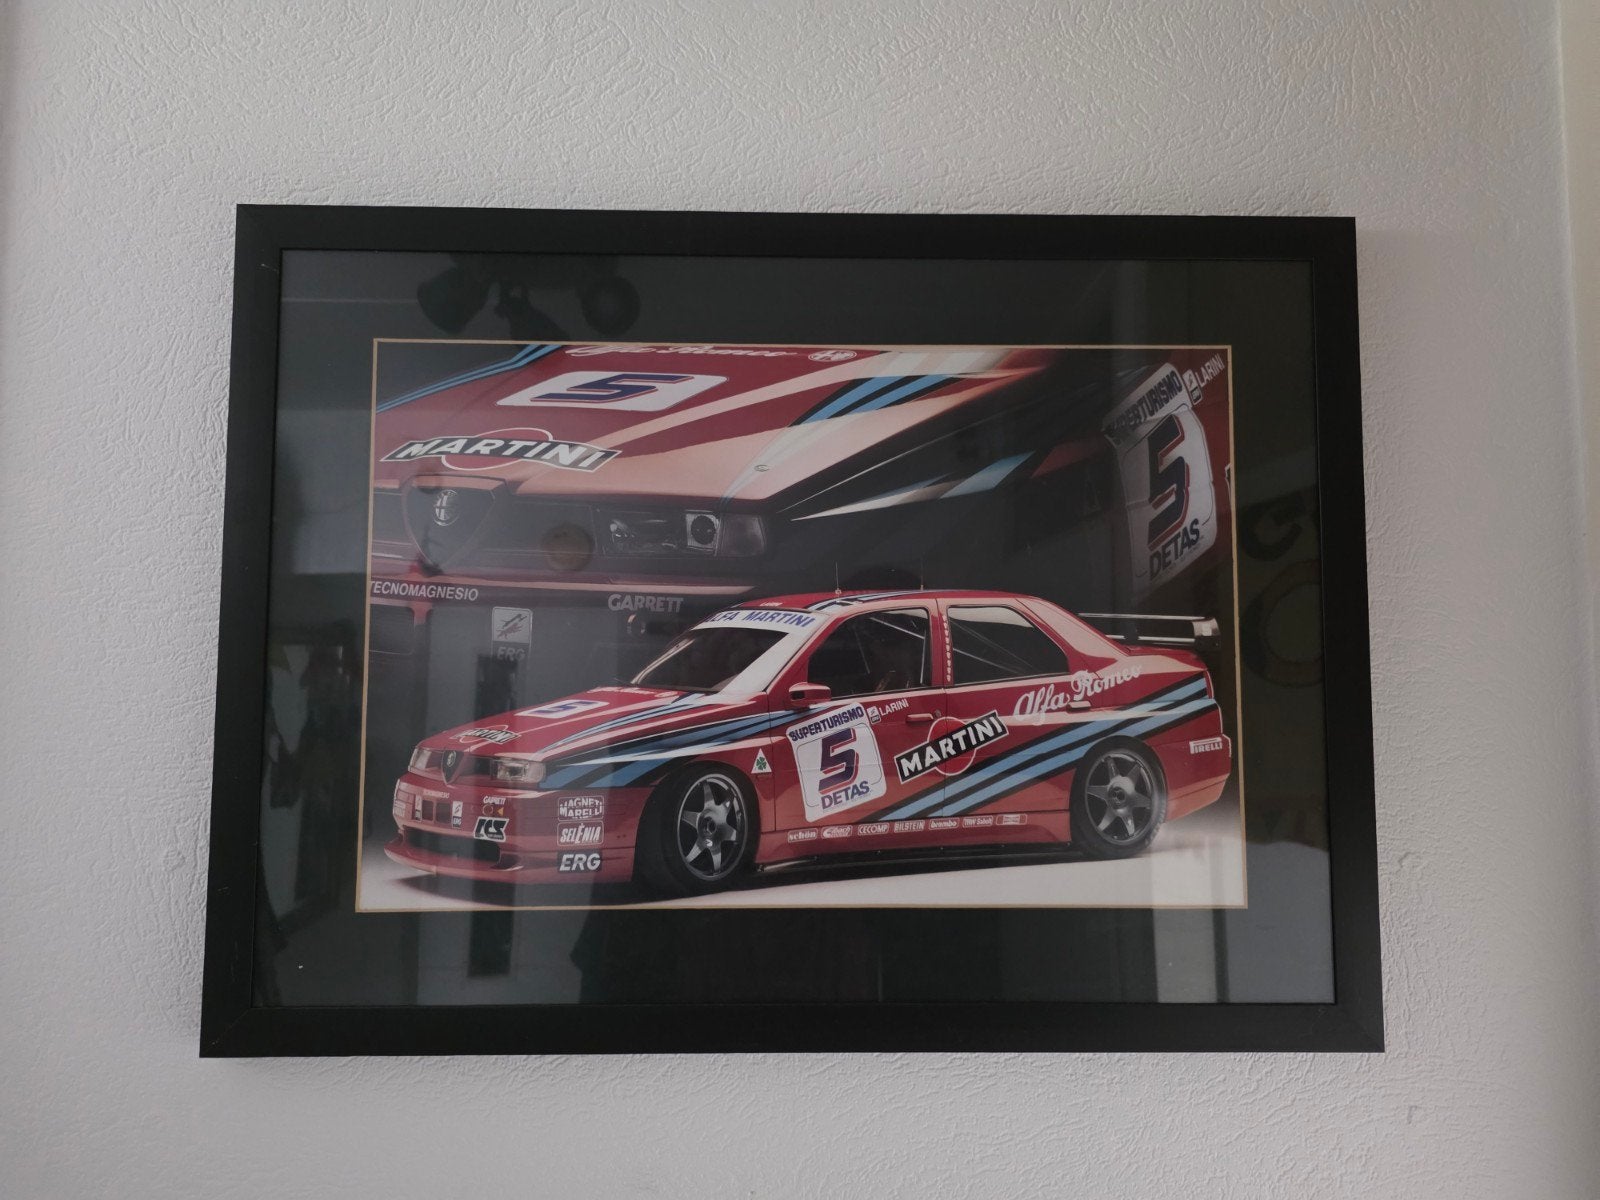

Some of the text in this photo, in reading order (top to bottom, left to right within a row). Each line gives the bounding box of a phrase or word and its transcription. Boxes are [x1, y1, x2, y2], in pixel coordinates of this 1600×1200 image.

[1194, 353, 1226, 387] LARINI
[530, 373, 694, 403] 5
[396, 438, 605, 468] MARTINI
[1148, 414, 1190, 551] 5
[1149, 518, 1201, 577] DETAS
[608, 594, 683, 612] GARRETT
[741, 611, 816, 627] MARTINI
[879, 699, 909, 716] LARINI
[1013, 665, 1141, 726] Alfa Romeo
[789, 706, 865, 741] SUPERTURISMO
[900, 715, 1003, 778] MARTINI
[1189, 737, 1223, 754] PIRELLI
[819, 728, 860, 795] 5
[821, 781, 870, 810] DETAS
[894, 820, 925, 832] BILSTEIN
[559, 853, 601, 871] ERG
